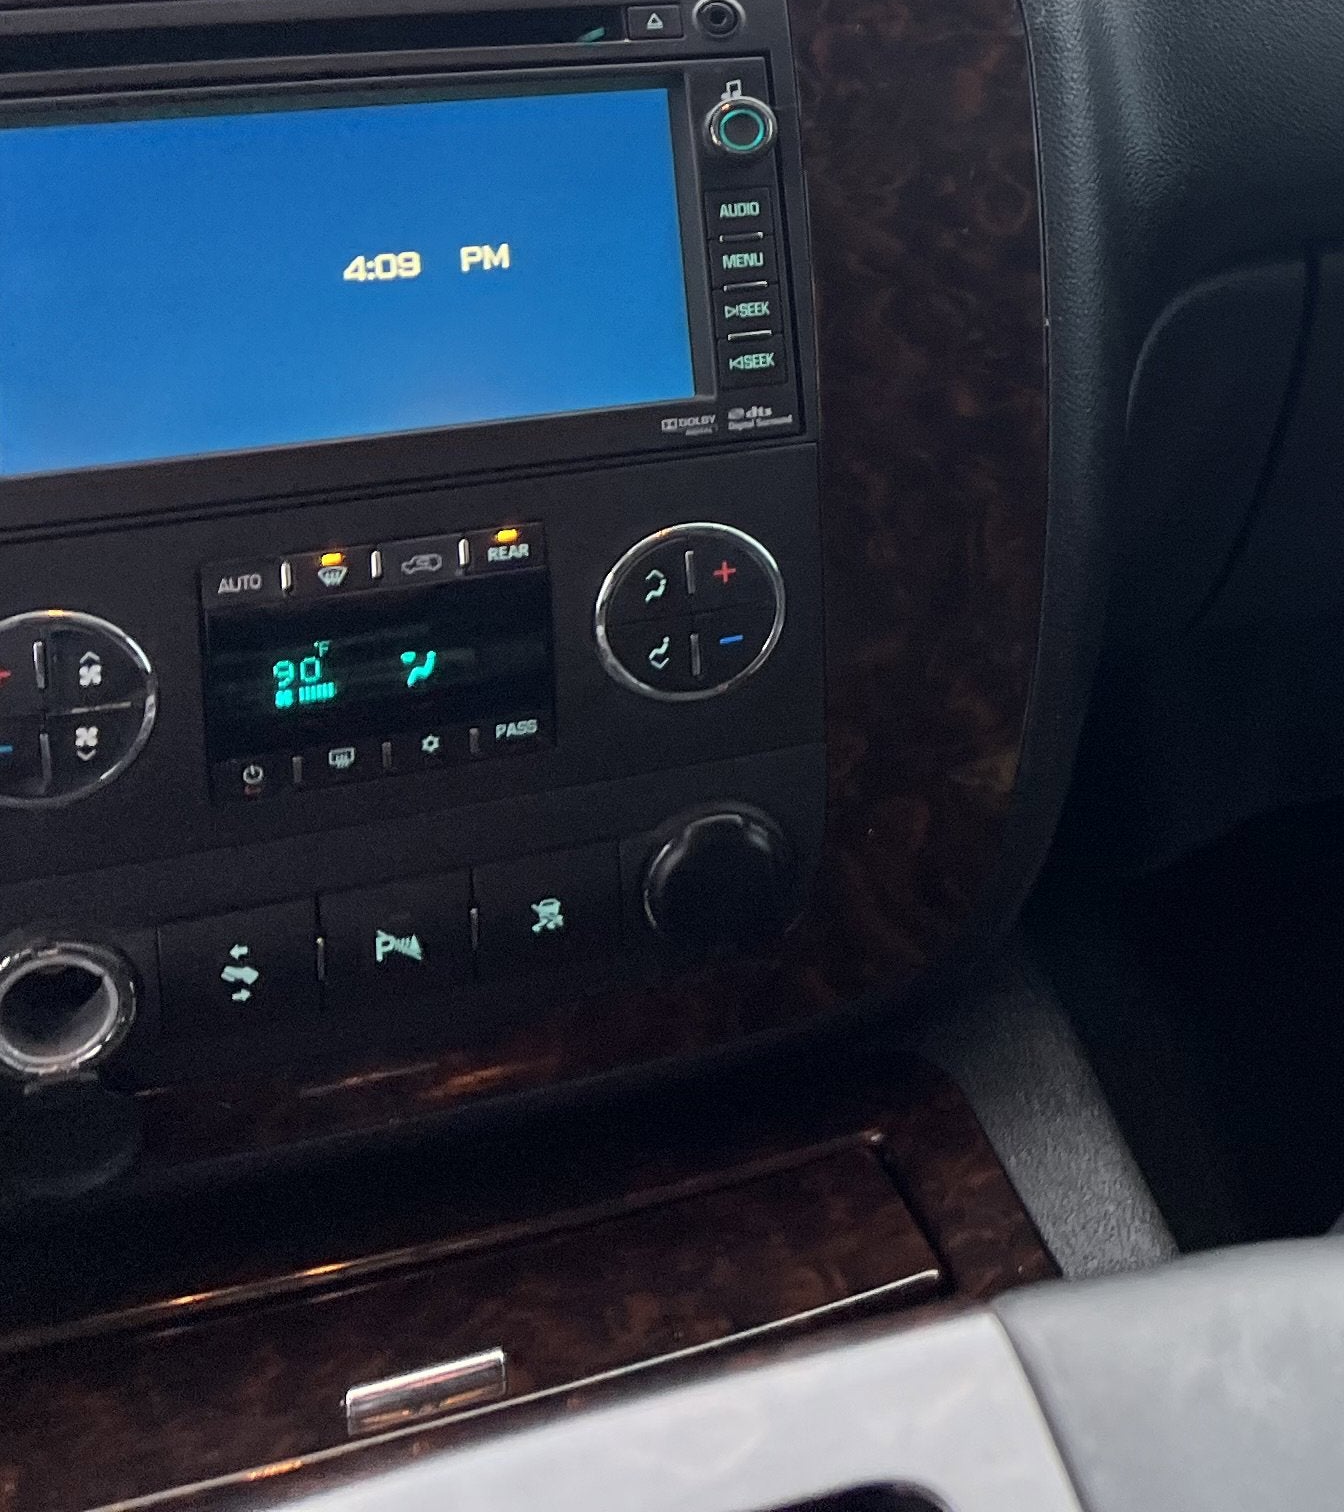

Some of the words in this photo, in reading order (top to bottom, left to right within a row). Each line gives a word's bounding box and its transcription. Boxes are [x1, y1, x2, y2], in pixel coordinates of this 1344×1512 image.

[719, 201, 760, 219] AUDIO
[343, 251, 421, 282] 4:09
[460, 243, 510, 273] PM
[722, 252, 764, 270] MENU
[739, 301, 771, 318] SEEK
[743, 352, 775, 370] SEEK
[679, 414, 716, 428] DOLBY
[745, 406, 773, 418] dts
[487, 543, 530, 563] REAR
[218, 573, 261, 594] AUTO
[273, 656, 321, 688] 90
[495, 719, 537, 742] PASS
